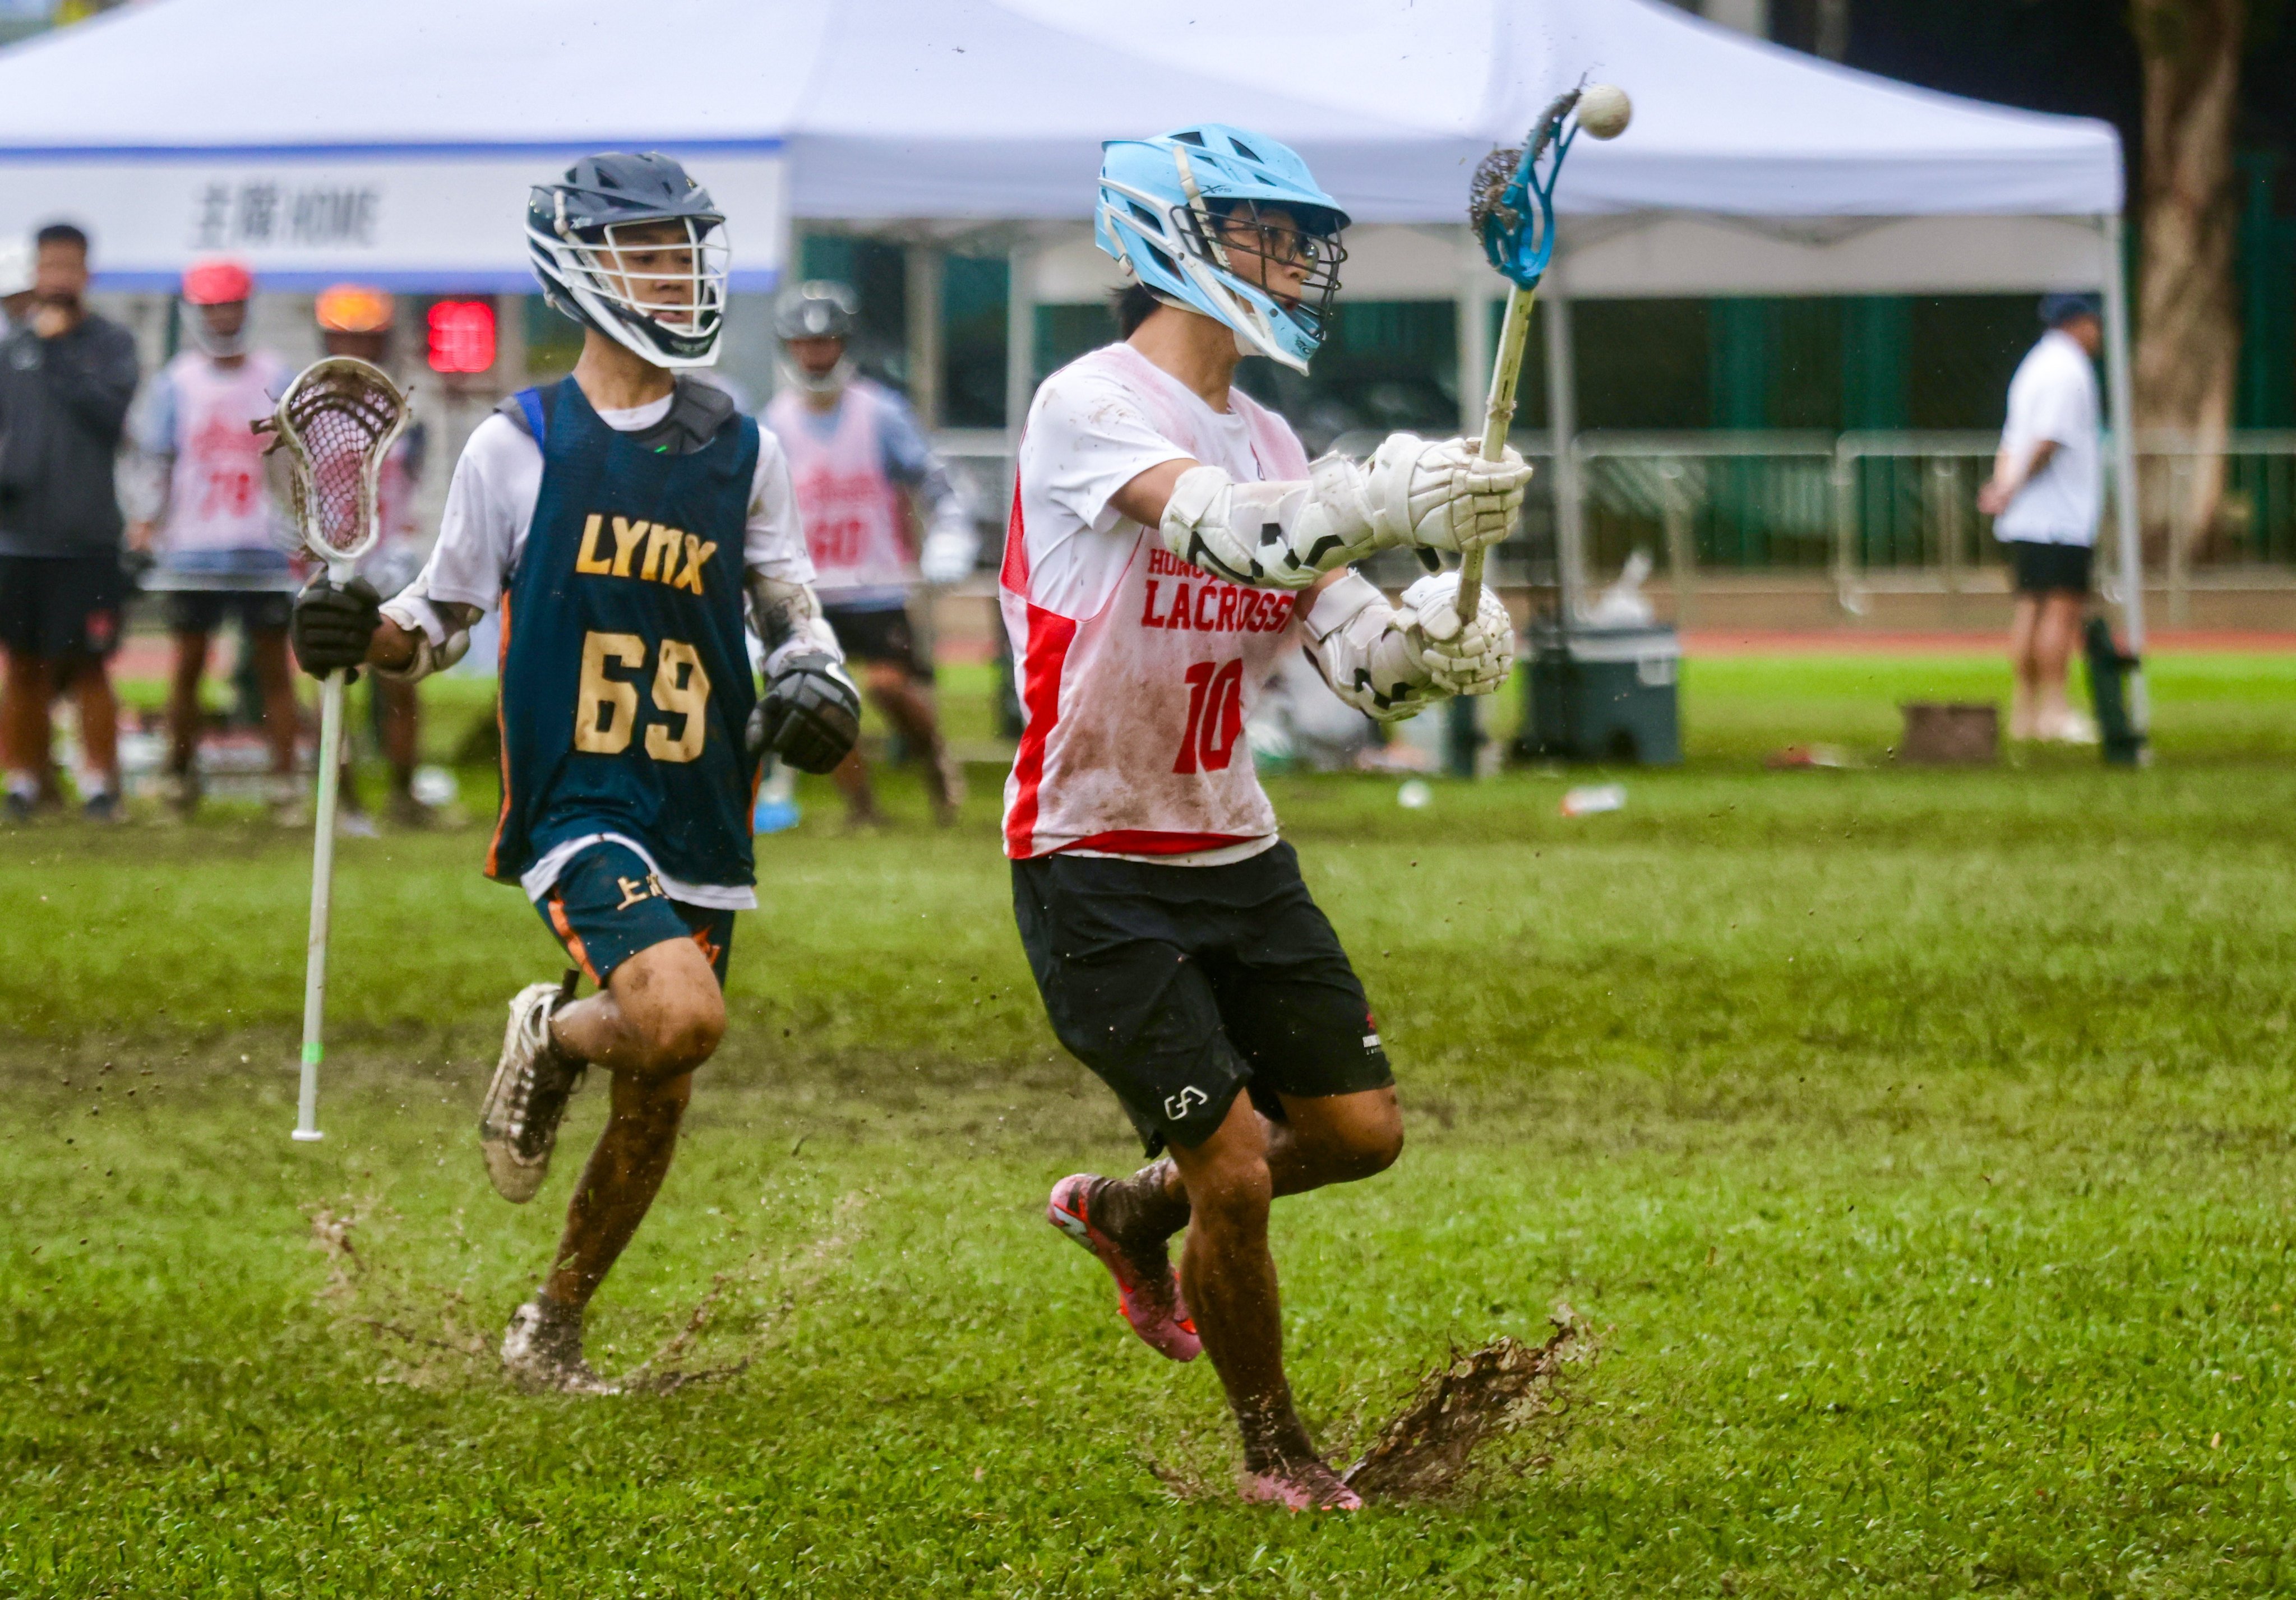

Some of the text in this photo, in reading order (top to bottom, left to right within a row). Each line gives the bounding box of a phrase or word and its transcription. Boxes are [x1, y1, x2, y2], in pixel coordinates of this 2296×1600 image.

[1140, 580, 1295, 634] LACROSS
[574, 630, 710, 763] 69
[1172, 657, 1243, 775] 10
